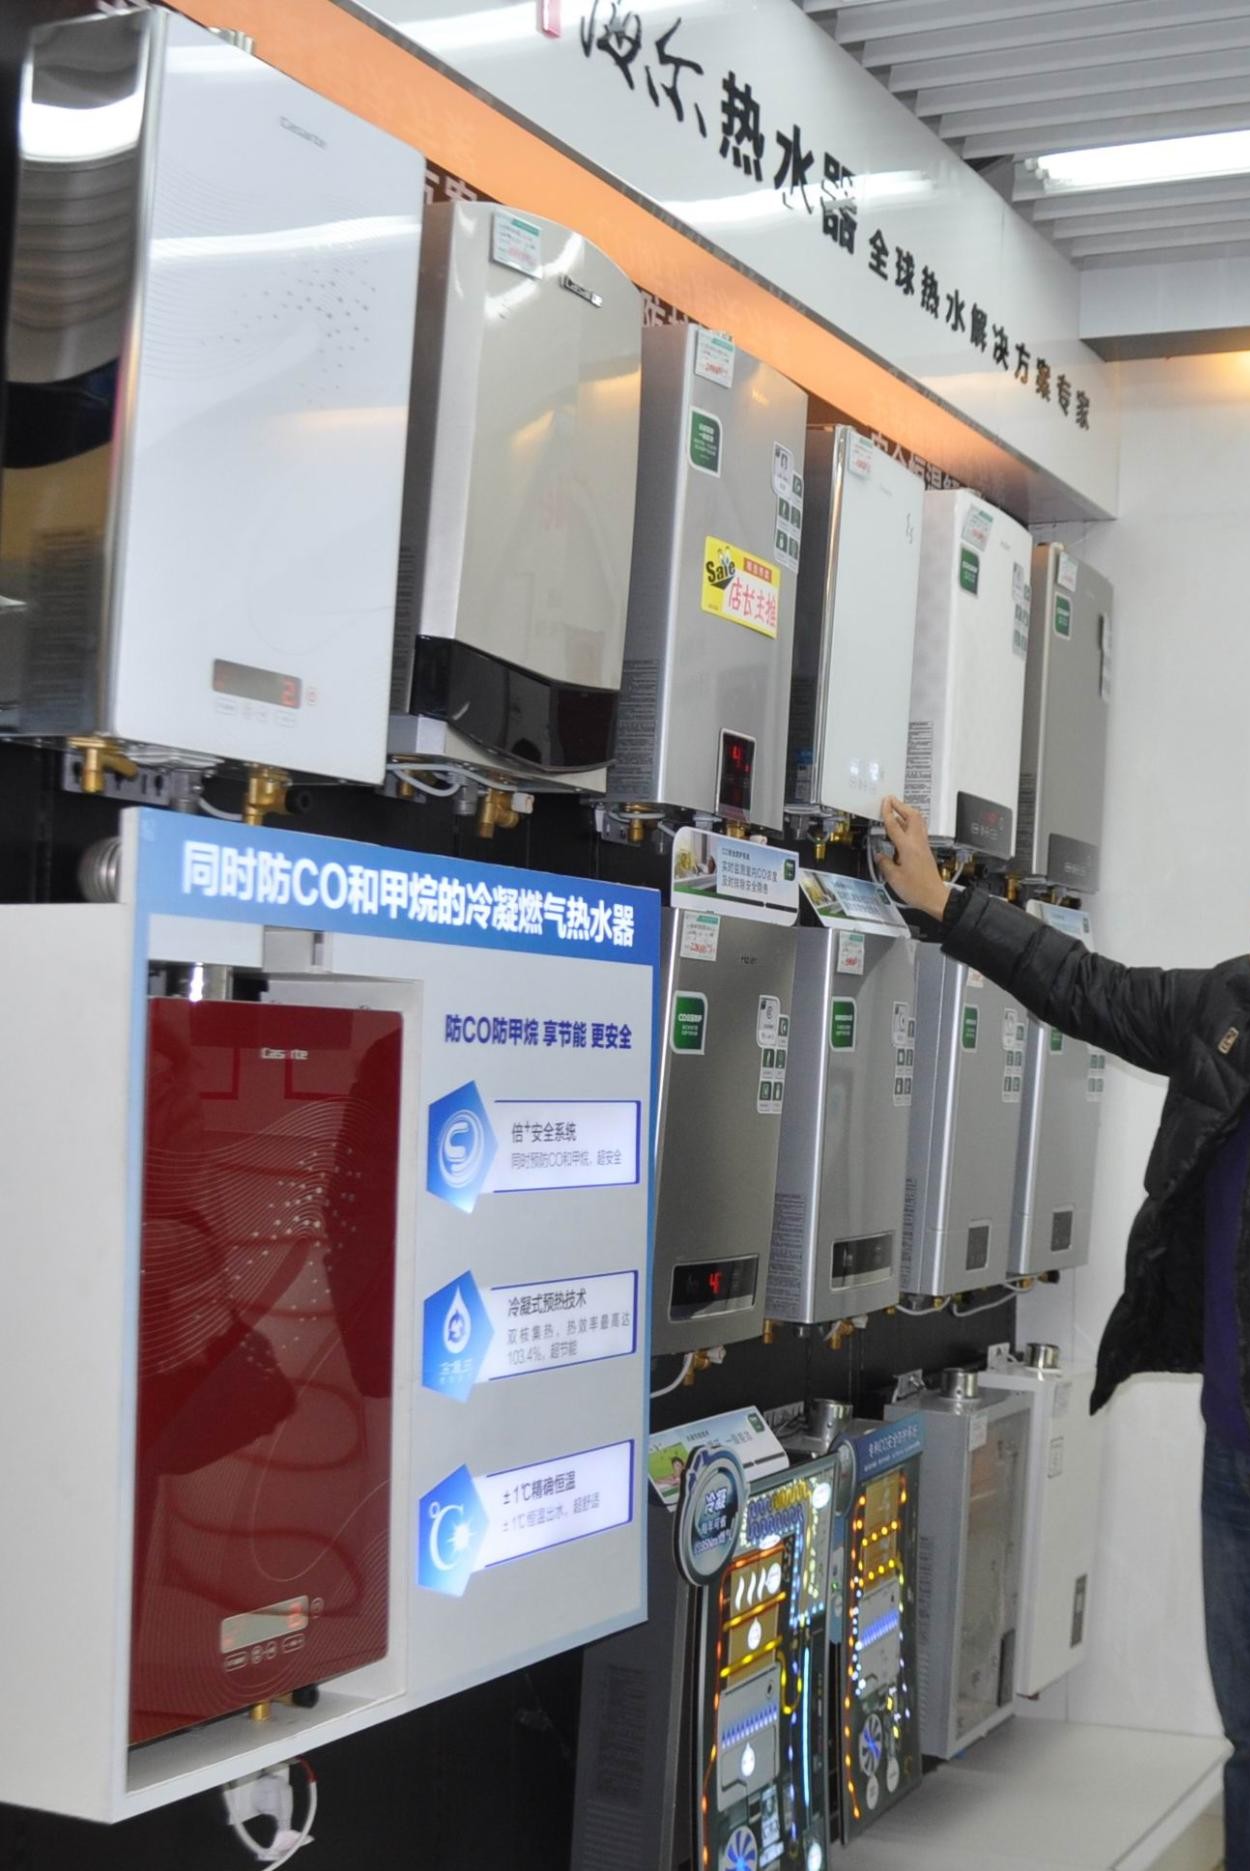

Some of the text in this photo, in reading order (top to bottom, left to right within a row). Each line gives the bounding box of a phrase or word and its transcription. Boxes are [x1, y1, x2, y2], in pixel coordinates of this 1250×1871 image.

[868, 227, 1091, 431] 全球热水解决方案专家
[705, 557, 736, 583] Sale
[181, 839, 636, 948] 同时防CO和甲烷的冷凝燃气热水器
[444, 1014, 633, 1050] 防CO防甲烷 享节能 更安全
[508, 1288, 587, 1318] 冷凝式预热技术
